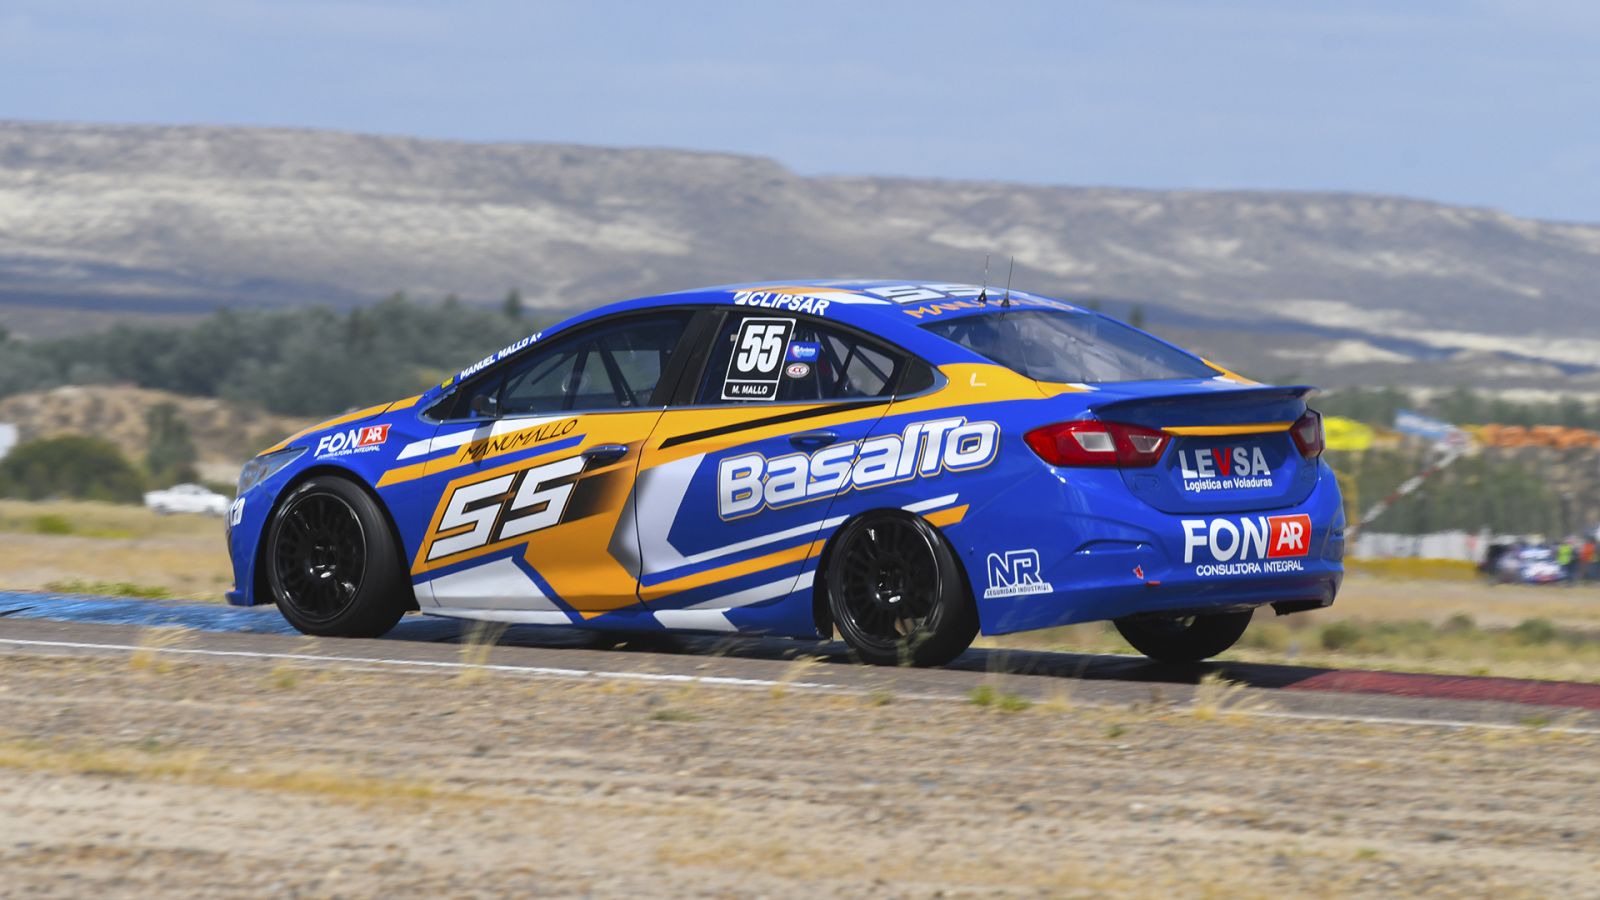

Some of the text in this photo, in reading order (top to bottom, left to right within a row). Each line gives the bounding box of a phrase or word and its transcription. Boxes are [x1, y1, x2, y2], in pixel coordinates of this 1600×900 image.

[748, 292, 830, 316] CLIPSAR
[460, 355, 495, 380] MANUEL
[497, 337, 529, 360] MALLO
[737, 325, 785, 373] 55
[731, 385, 768, 395] M. MALLO
[460, 419, 577, 463] MANUMALLO
[1178, 447, 1271, 478] LEVSA
[1223, 479, 1233, 489] en
[1233, 477, 1273, 488] Voladuras
[425, 454, 590, 562] 55
[987, 548, 1044, 588] NR
[1196, 560, 1304, 577] CONSULTORA INTEGRAL
[986, 587, 1017, 597] SEGURIDAD
